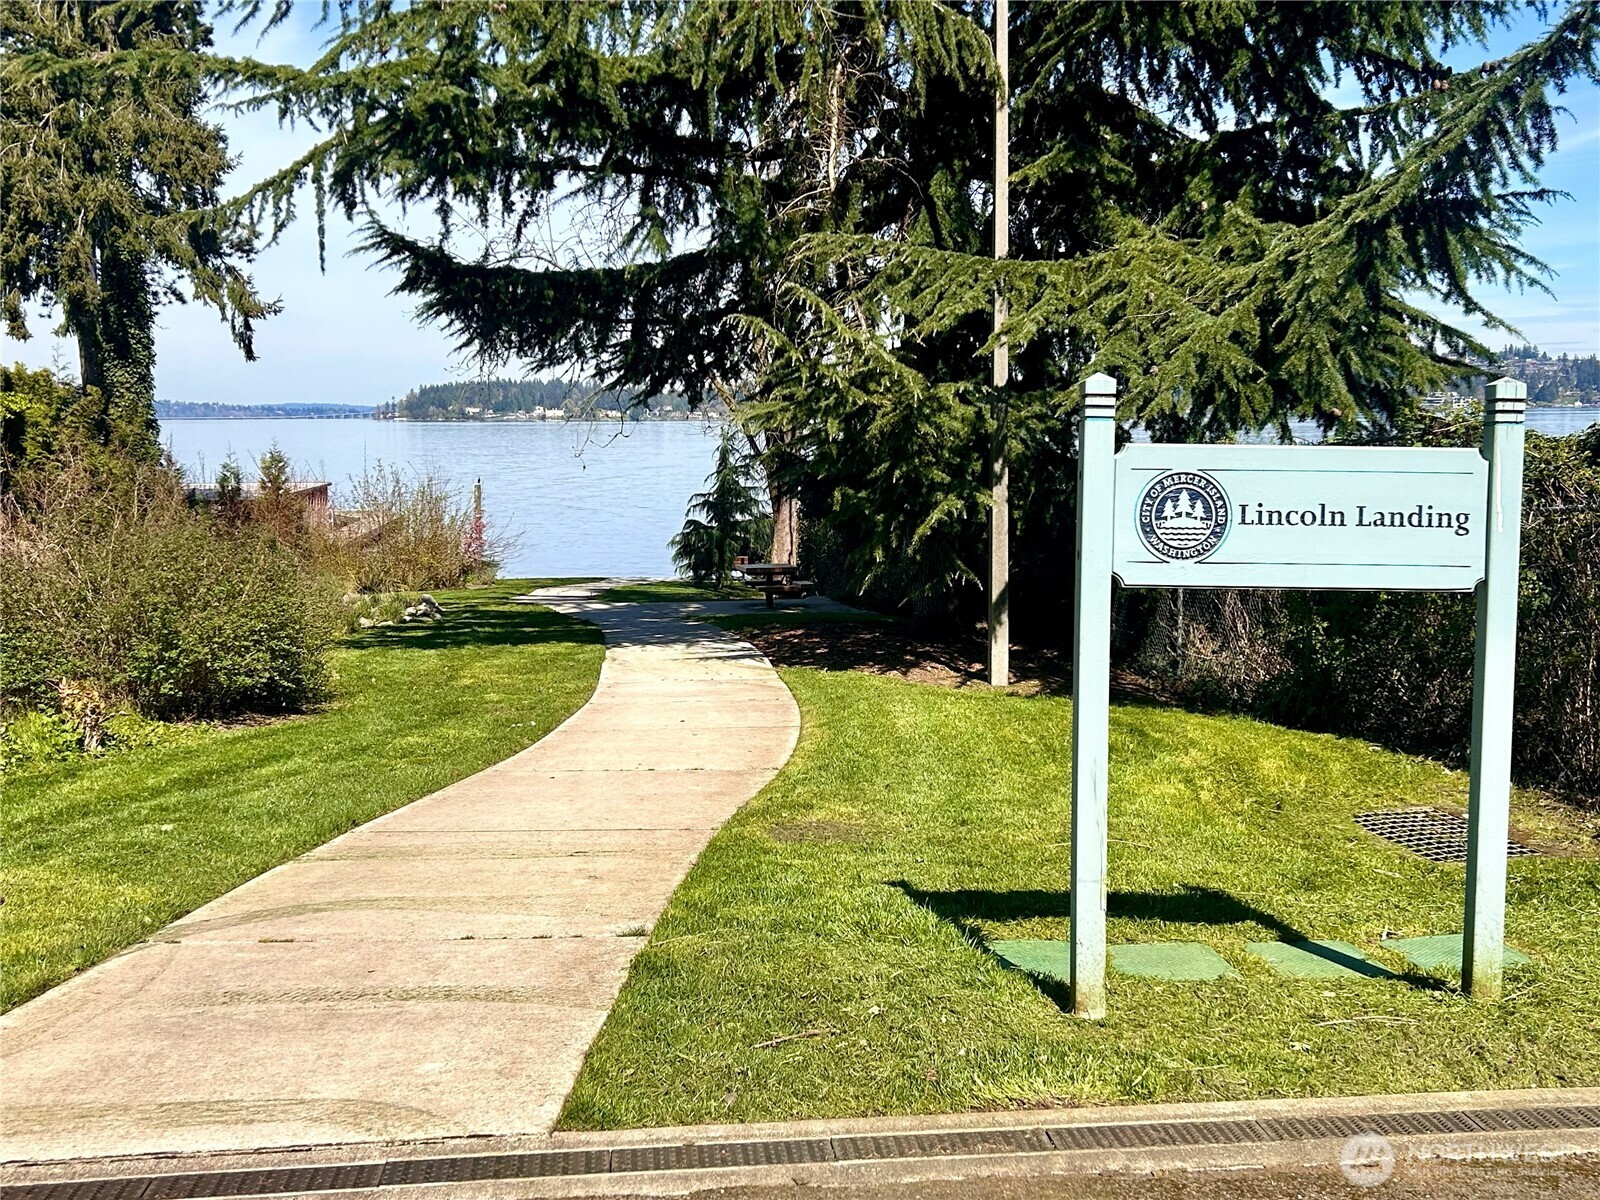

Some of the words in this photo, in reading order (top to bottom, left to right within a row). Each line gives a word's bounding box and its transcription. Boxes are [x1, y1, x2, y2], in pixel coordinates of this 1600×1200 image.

[1141, 497, 1154, 523] CITY
[1150, 485, 1162, 497] OF
[1163, 474, 1206, 487] MERCER
[1206, 485, 1226, 524] ISLAND
[1238, 503, 1347, 526] Lincoln
[1355, 505, 1471, 536] Landing
[1149, 534, 1217, 558] WASHINGTON
